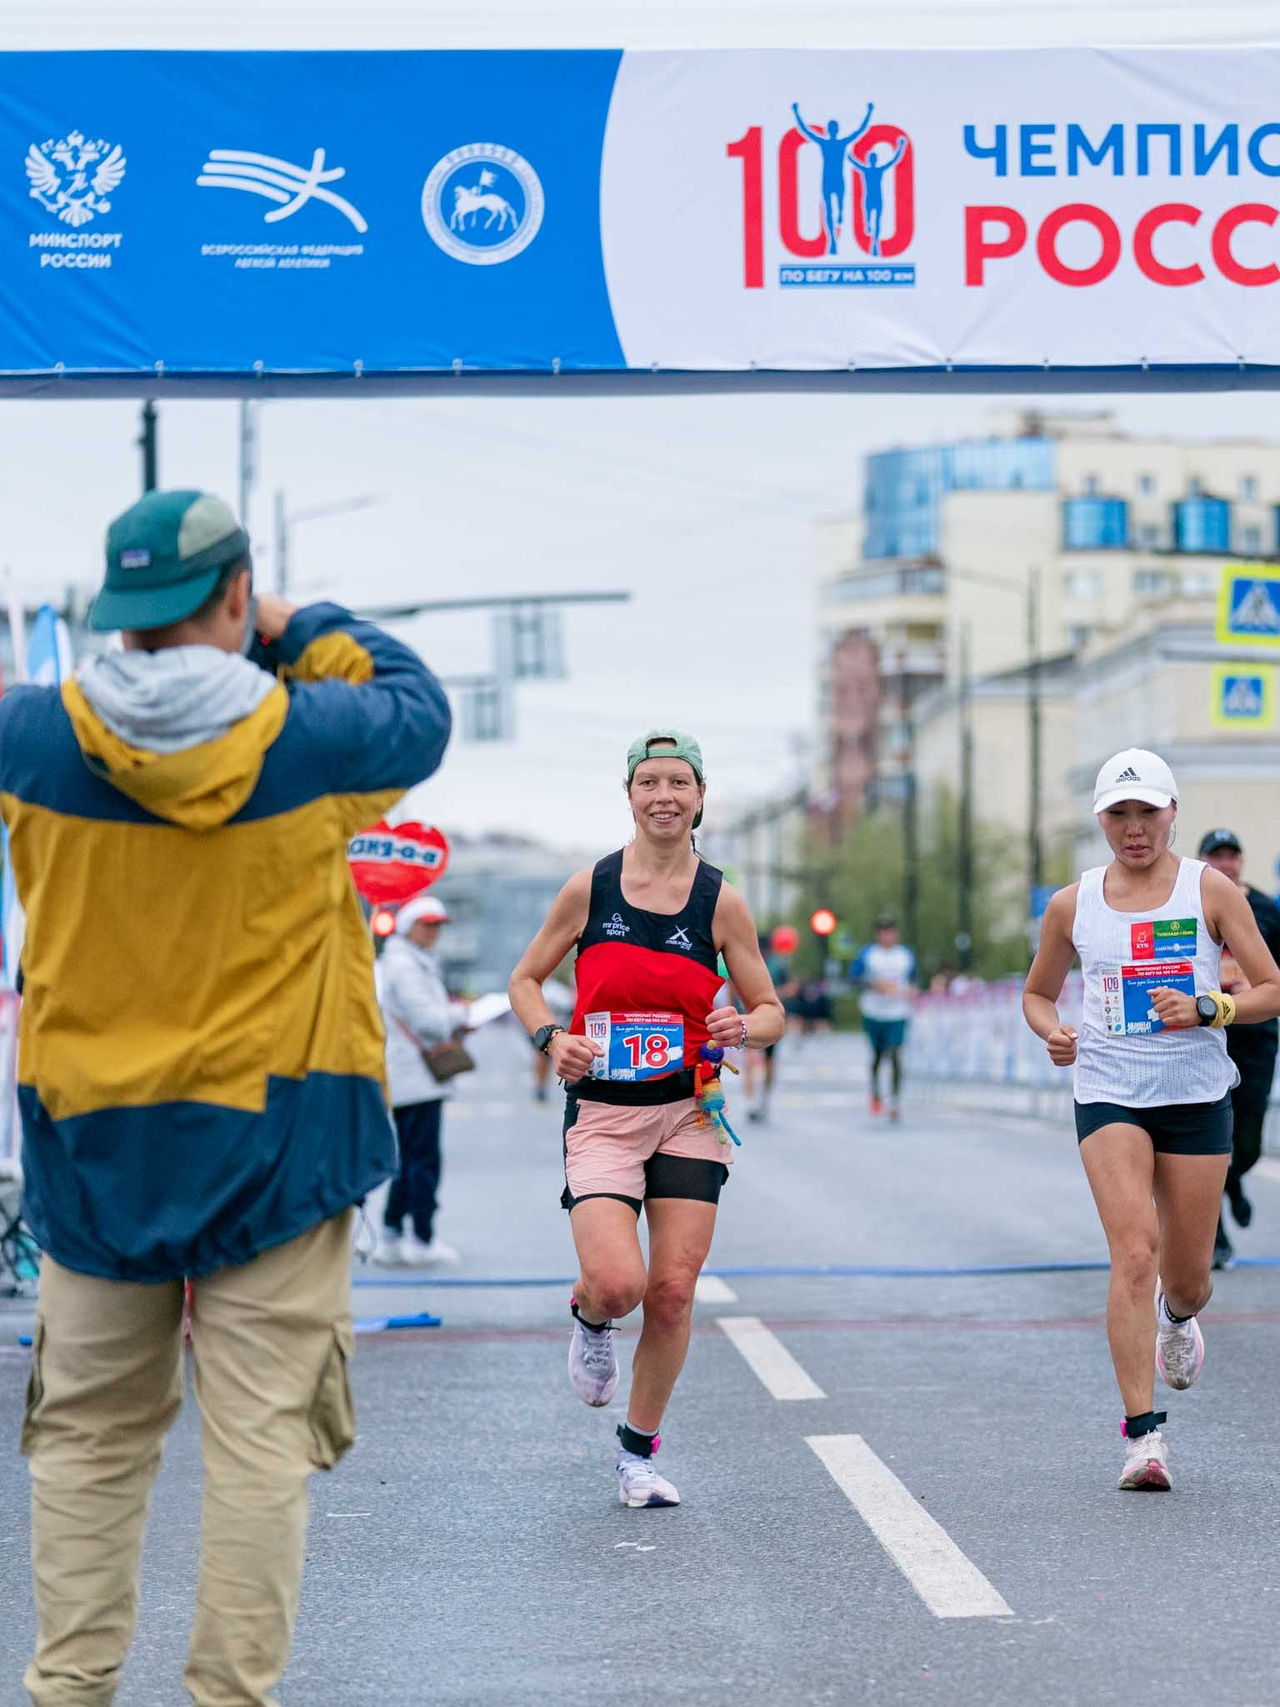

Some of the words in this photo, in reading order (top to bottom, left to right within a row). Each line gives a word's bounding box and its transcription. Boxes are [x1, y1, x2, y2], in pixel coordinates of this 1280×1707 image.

[726, 124, 916, 289] 100
[29, 232, 123, 249] МИНСПОРТ
[40, 252, 112, 269] РОССИИ
[781, 269, 804, 283] ПО
[805, 269, 840, 283] БЕГУ
[842, 269, 865, 283] НА
[866, 269, 893, 283] 100
[1116, 775, 1141, 783] adidas
[606, 929, 626, 937] sport
[612, 923, 631, 932] price
[1103, 977, 1119, 992] 100
[590, 1022, 607, 1038] 100
[623, 1033, 670, 1069] 18
